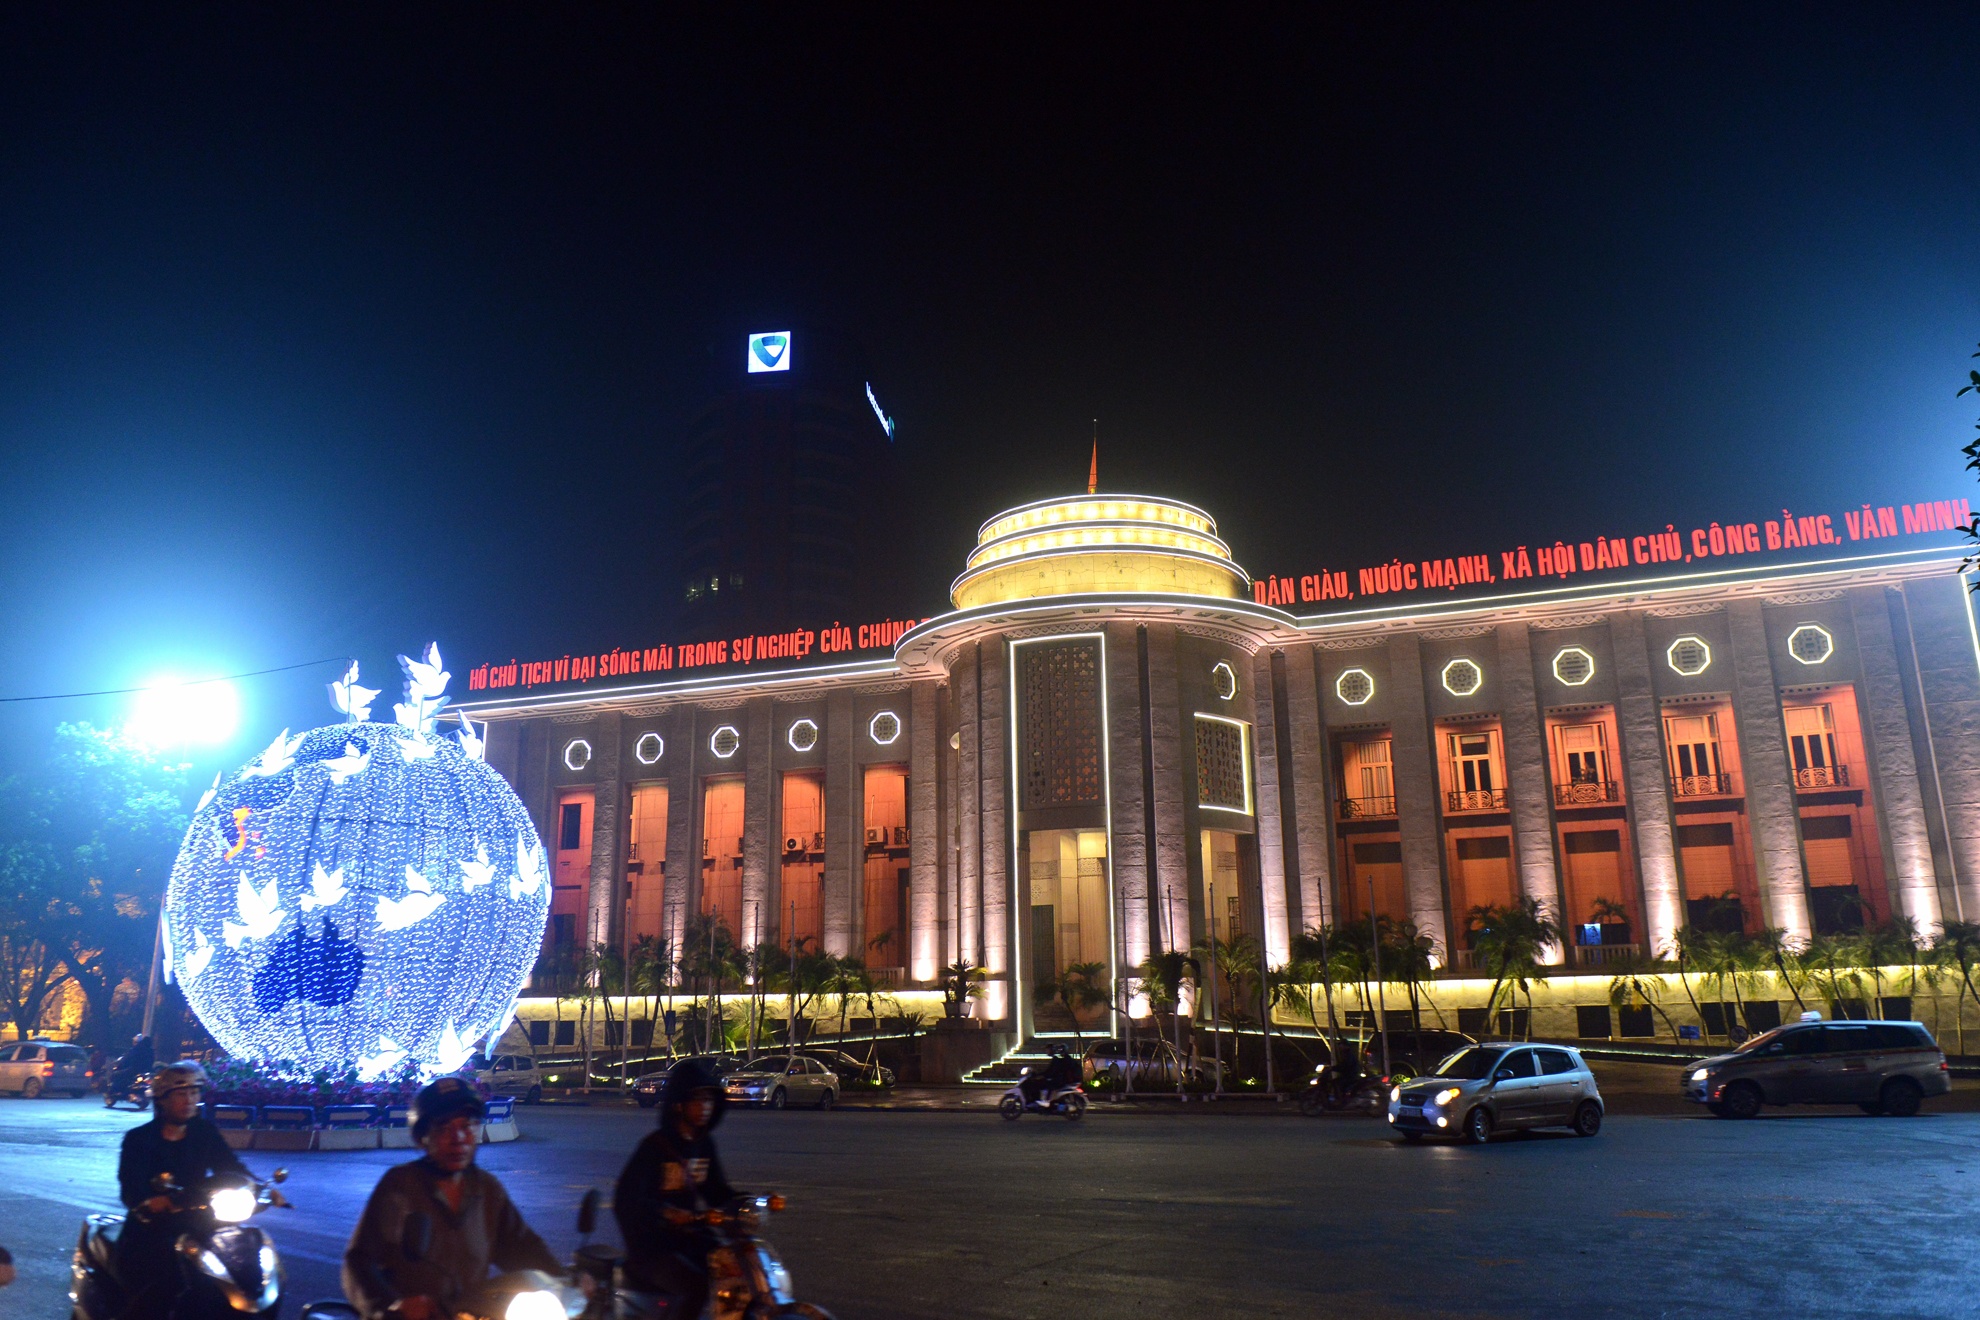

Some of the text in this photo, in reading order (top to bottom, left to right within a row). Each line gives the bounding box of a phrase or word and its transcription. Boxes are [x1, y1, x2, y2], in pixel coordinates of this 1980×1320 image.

[1254, 498, 1973, 606] DÂN GIÀU, NƯỚC MẠNH, XÃ HỘI DÂN CHỦ, CÔNG BẰNG, VĂN MINH
[469, 662, 489, 690] HỒ
[489, 658, 518, 689] CHỦ
[521, 661, 552, 689] TỊCH
[555, 655, 570, 682] VĨ
[571, 656, 596, 683] ĐẠI
[600, 647, 640, 677] SỐNG
[643, 644, 673, 672] MÃI
[678, 641, 727, 668] TRONG
[732, 635, 754, 665] SỰ
[756, 627, 815, 660] NGHIỆP
[820, 621, 853, 653] CỦA
